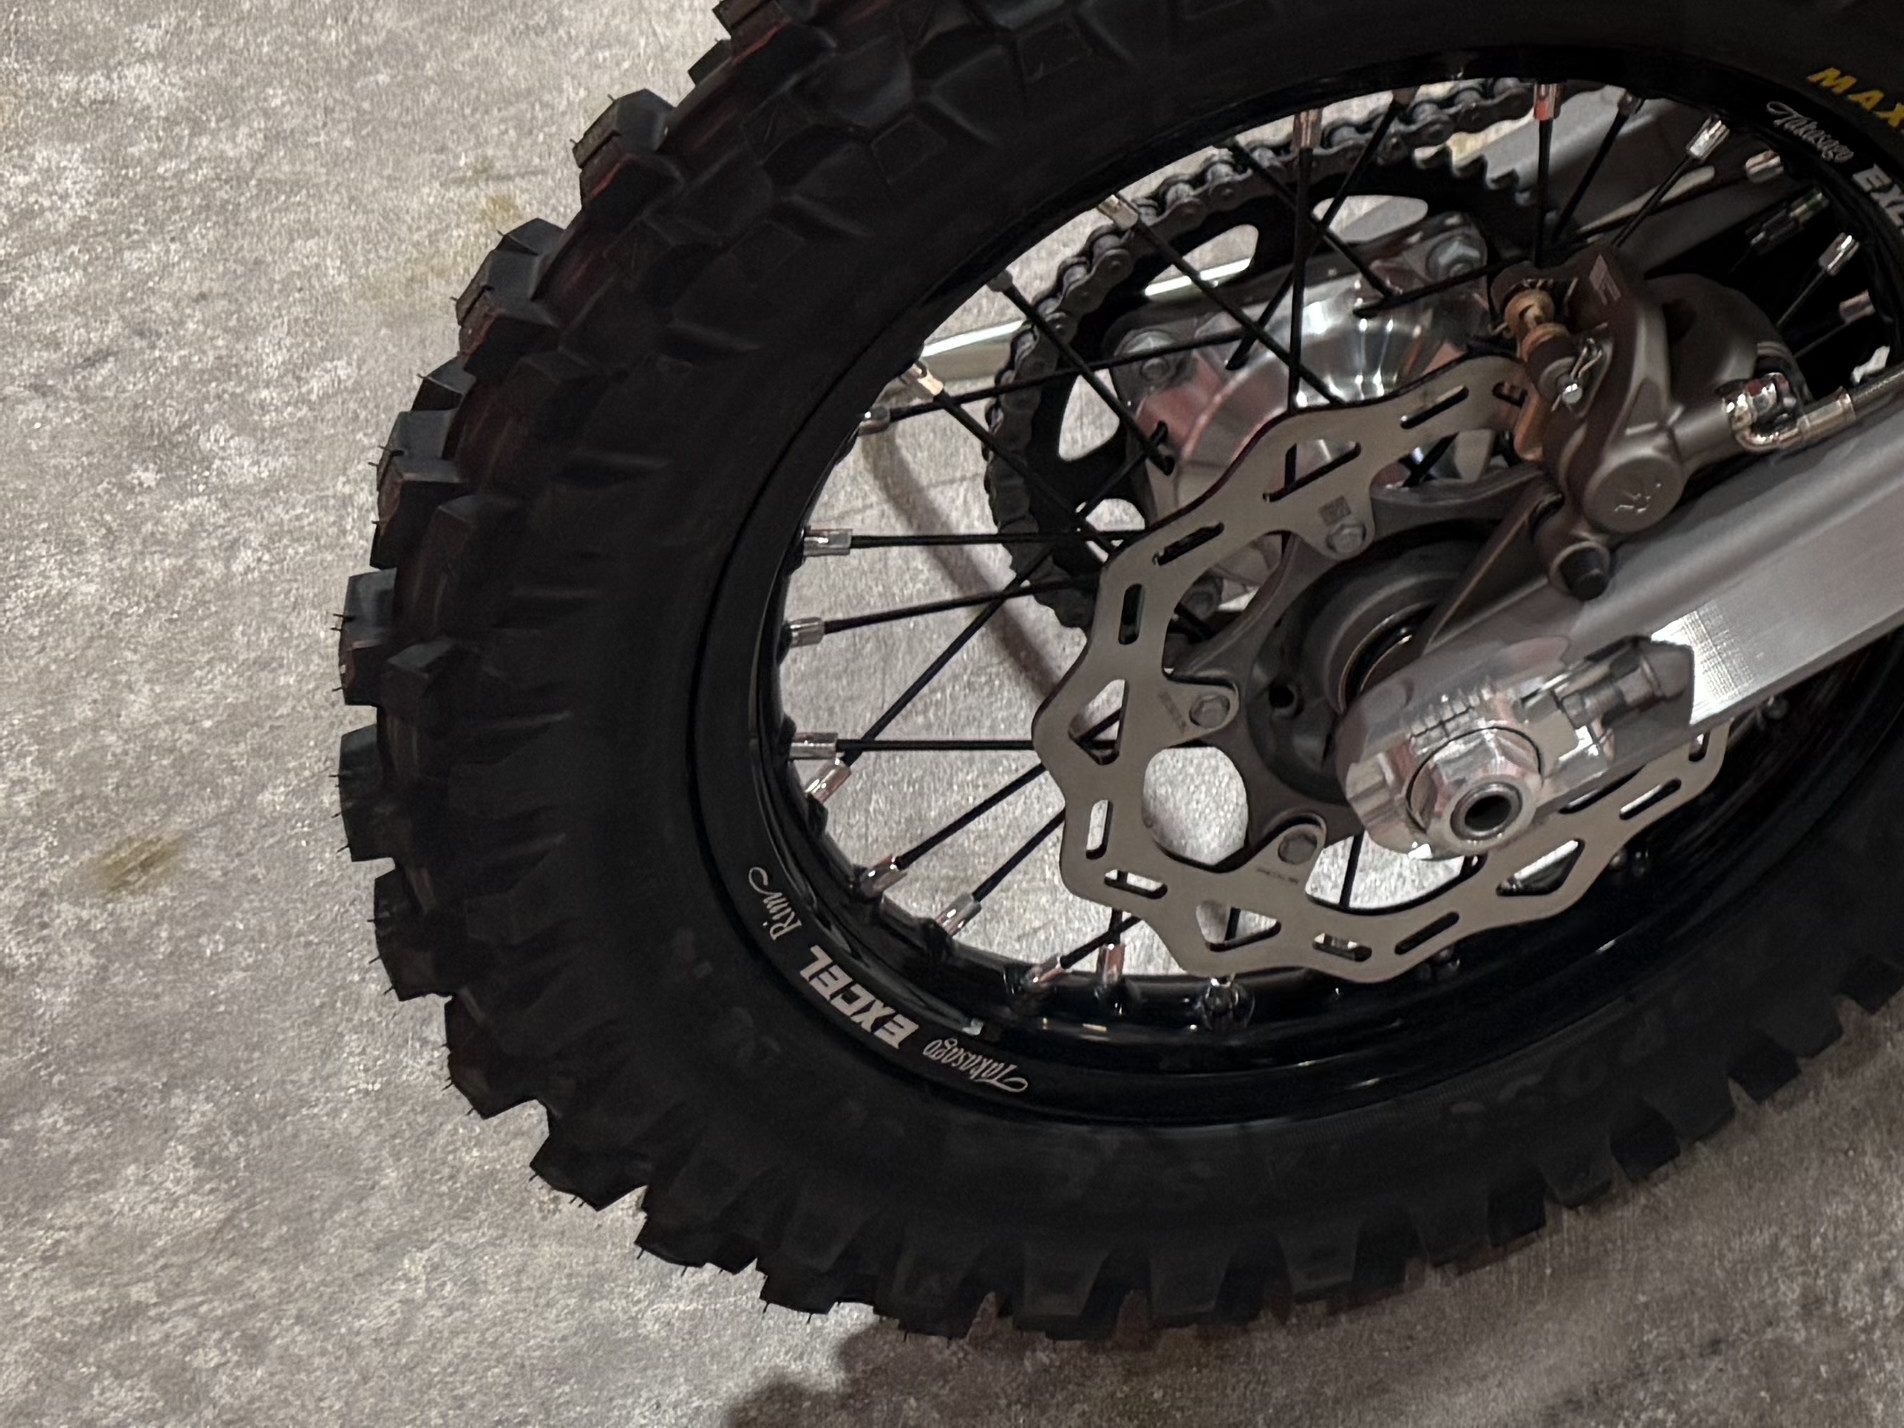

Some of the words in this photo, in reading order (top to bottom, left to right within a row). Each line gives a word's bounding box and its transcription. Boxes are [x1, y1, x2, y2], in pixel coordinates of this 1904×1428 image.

[748, 866, 802, 941] Rim
[799, 945, 920, 1049] EXCEL
[922, 1037, 1028, 1093] Takasago
